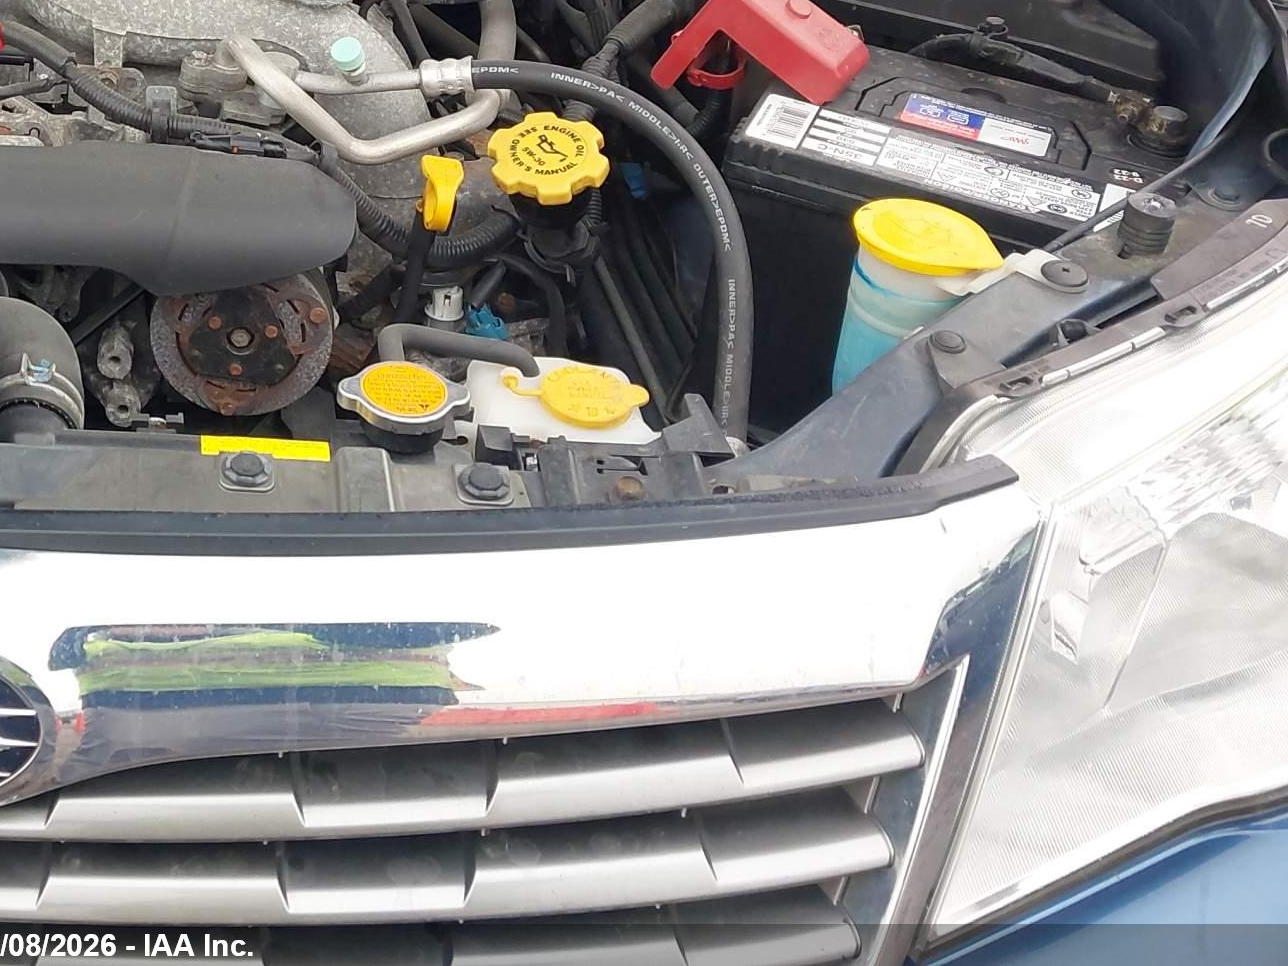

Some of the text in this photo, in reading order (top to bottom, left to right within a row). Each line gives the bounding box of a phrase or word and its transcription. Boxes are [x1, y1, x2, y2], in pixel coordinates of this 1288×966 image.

[510, 127, 578, 176] SEE OWNER'S MANUAL
[521, 146, 546, 166] 5W-30
[544, 124, 585, 157] ENGINE OIL
